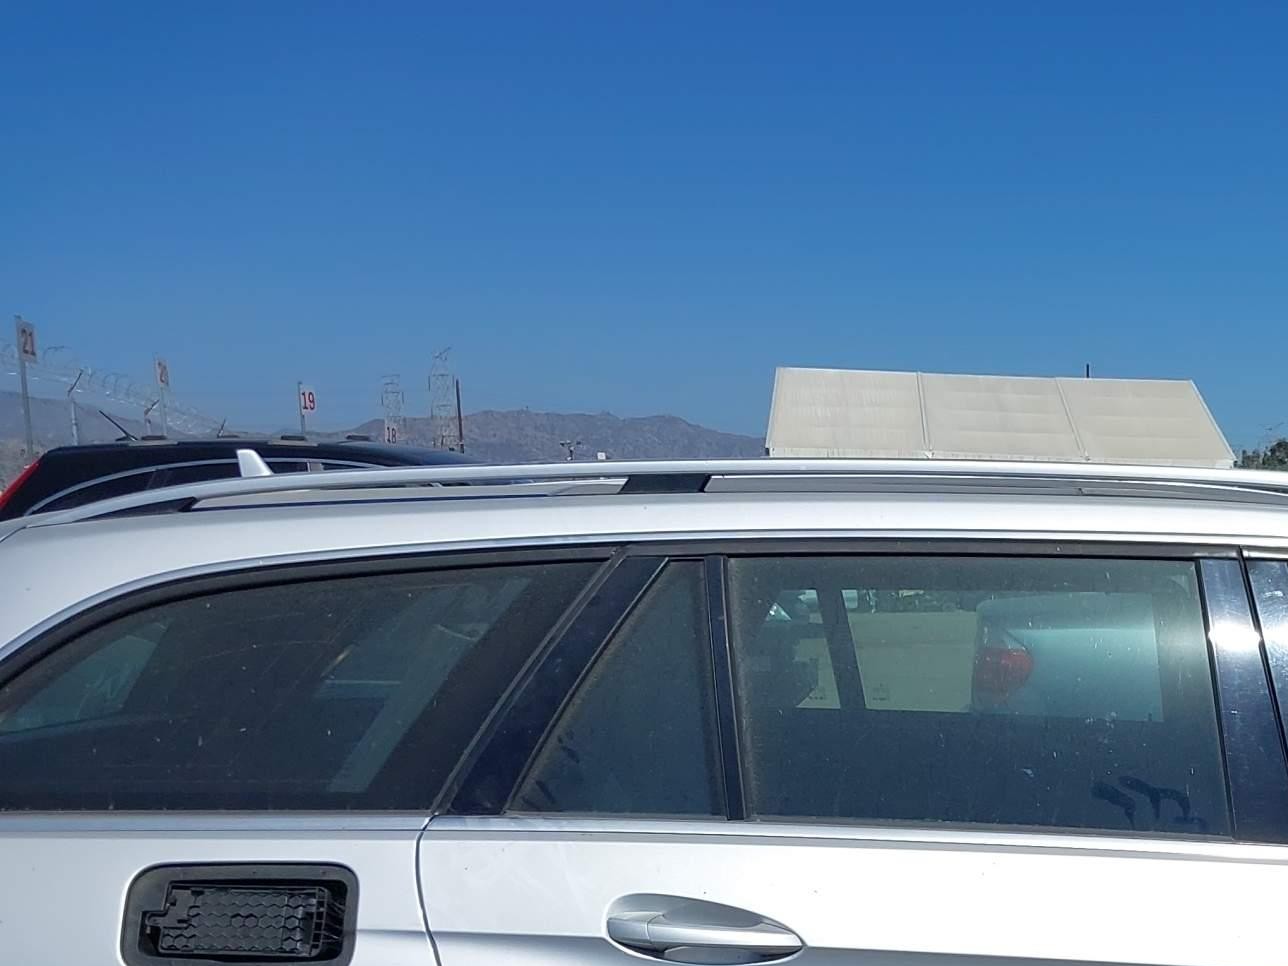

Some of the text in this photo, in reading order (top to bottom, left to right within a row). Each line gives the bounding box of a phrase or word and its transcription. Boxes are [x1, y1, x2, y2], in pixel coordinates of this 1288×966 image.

[20, 328, 36, 356] 21
[301, 391, 316, 410] 19
[386, 426, 397, 444] 18
